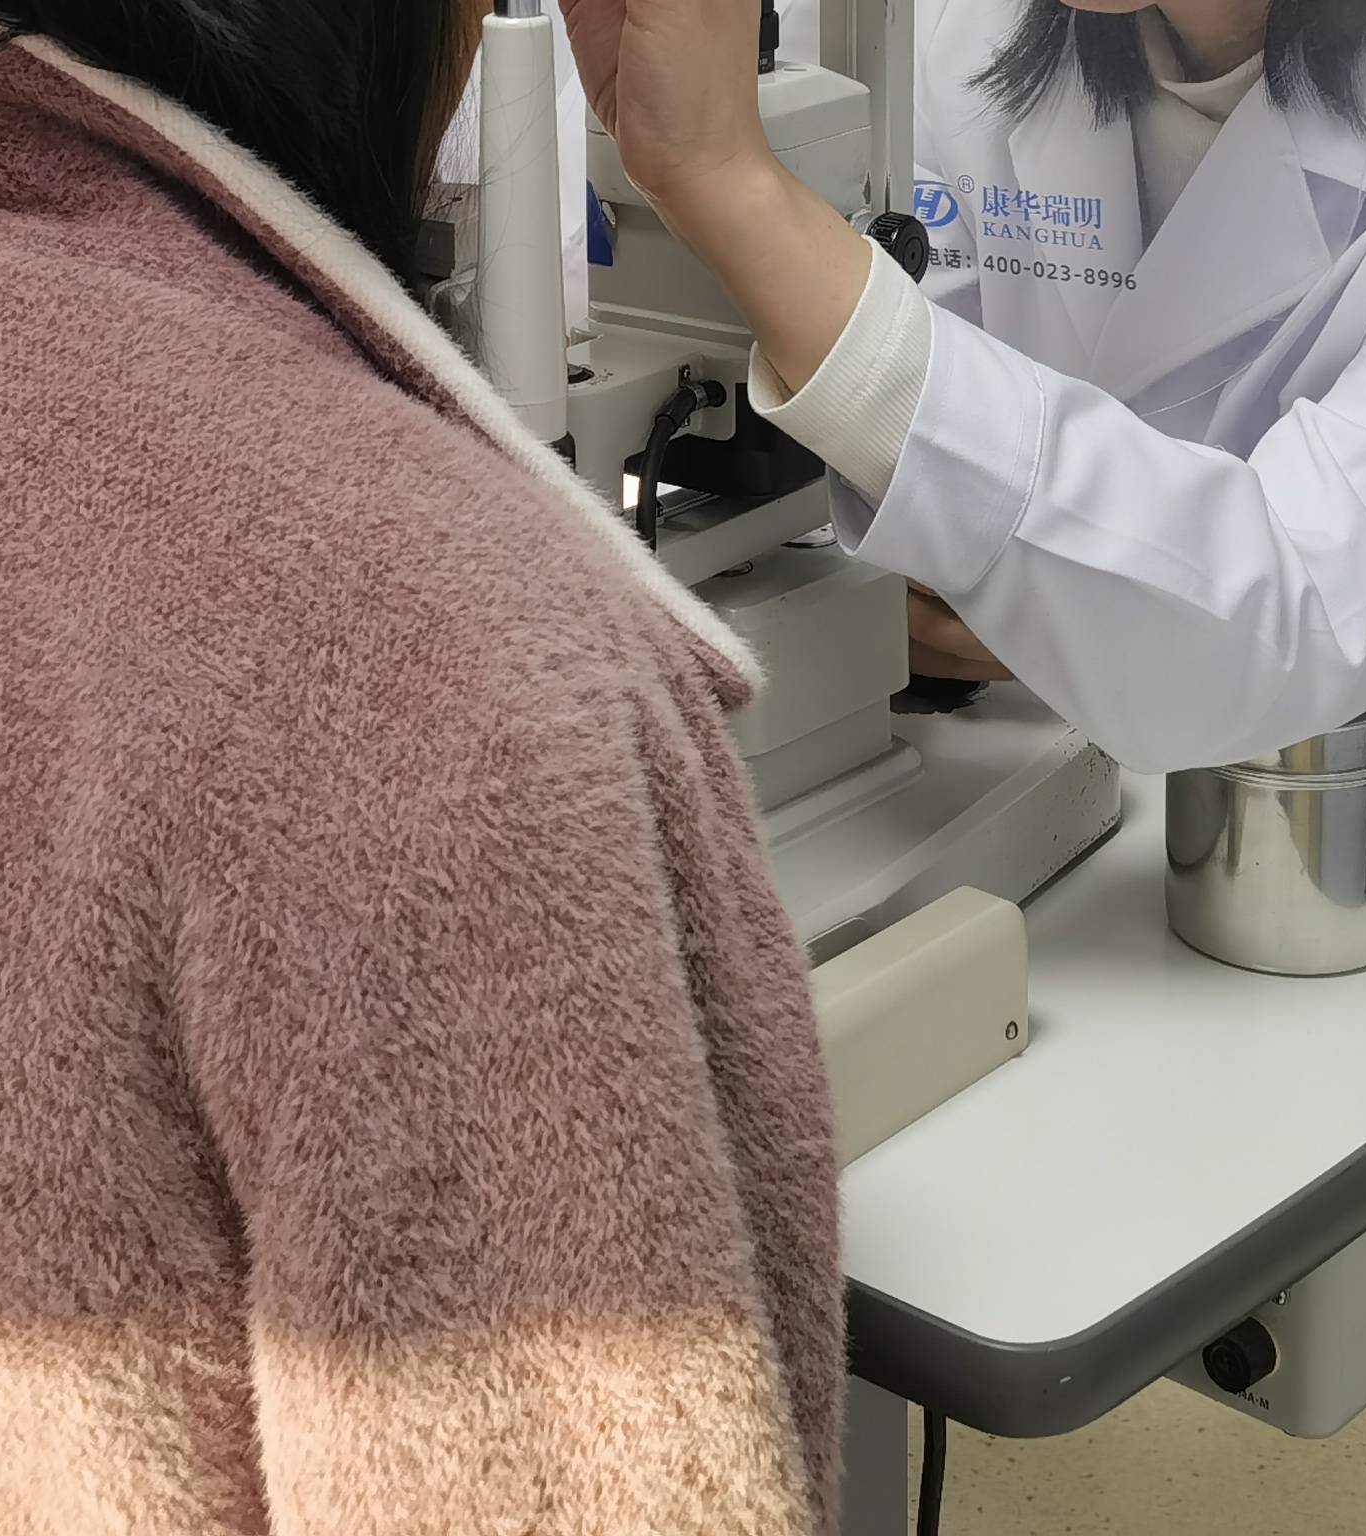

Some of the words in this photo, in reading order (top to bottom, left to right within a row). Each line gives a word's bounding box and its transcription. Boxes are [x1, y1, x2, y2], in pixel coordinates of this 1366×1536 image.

[981, 185, 1102, 230] 康华瑞明
[982, 221, 1105, 251] KANGHUA
[983, 255, 1138, 290] 400-023-8996
